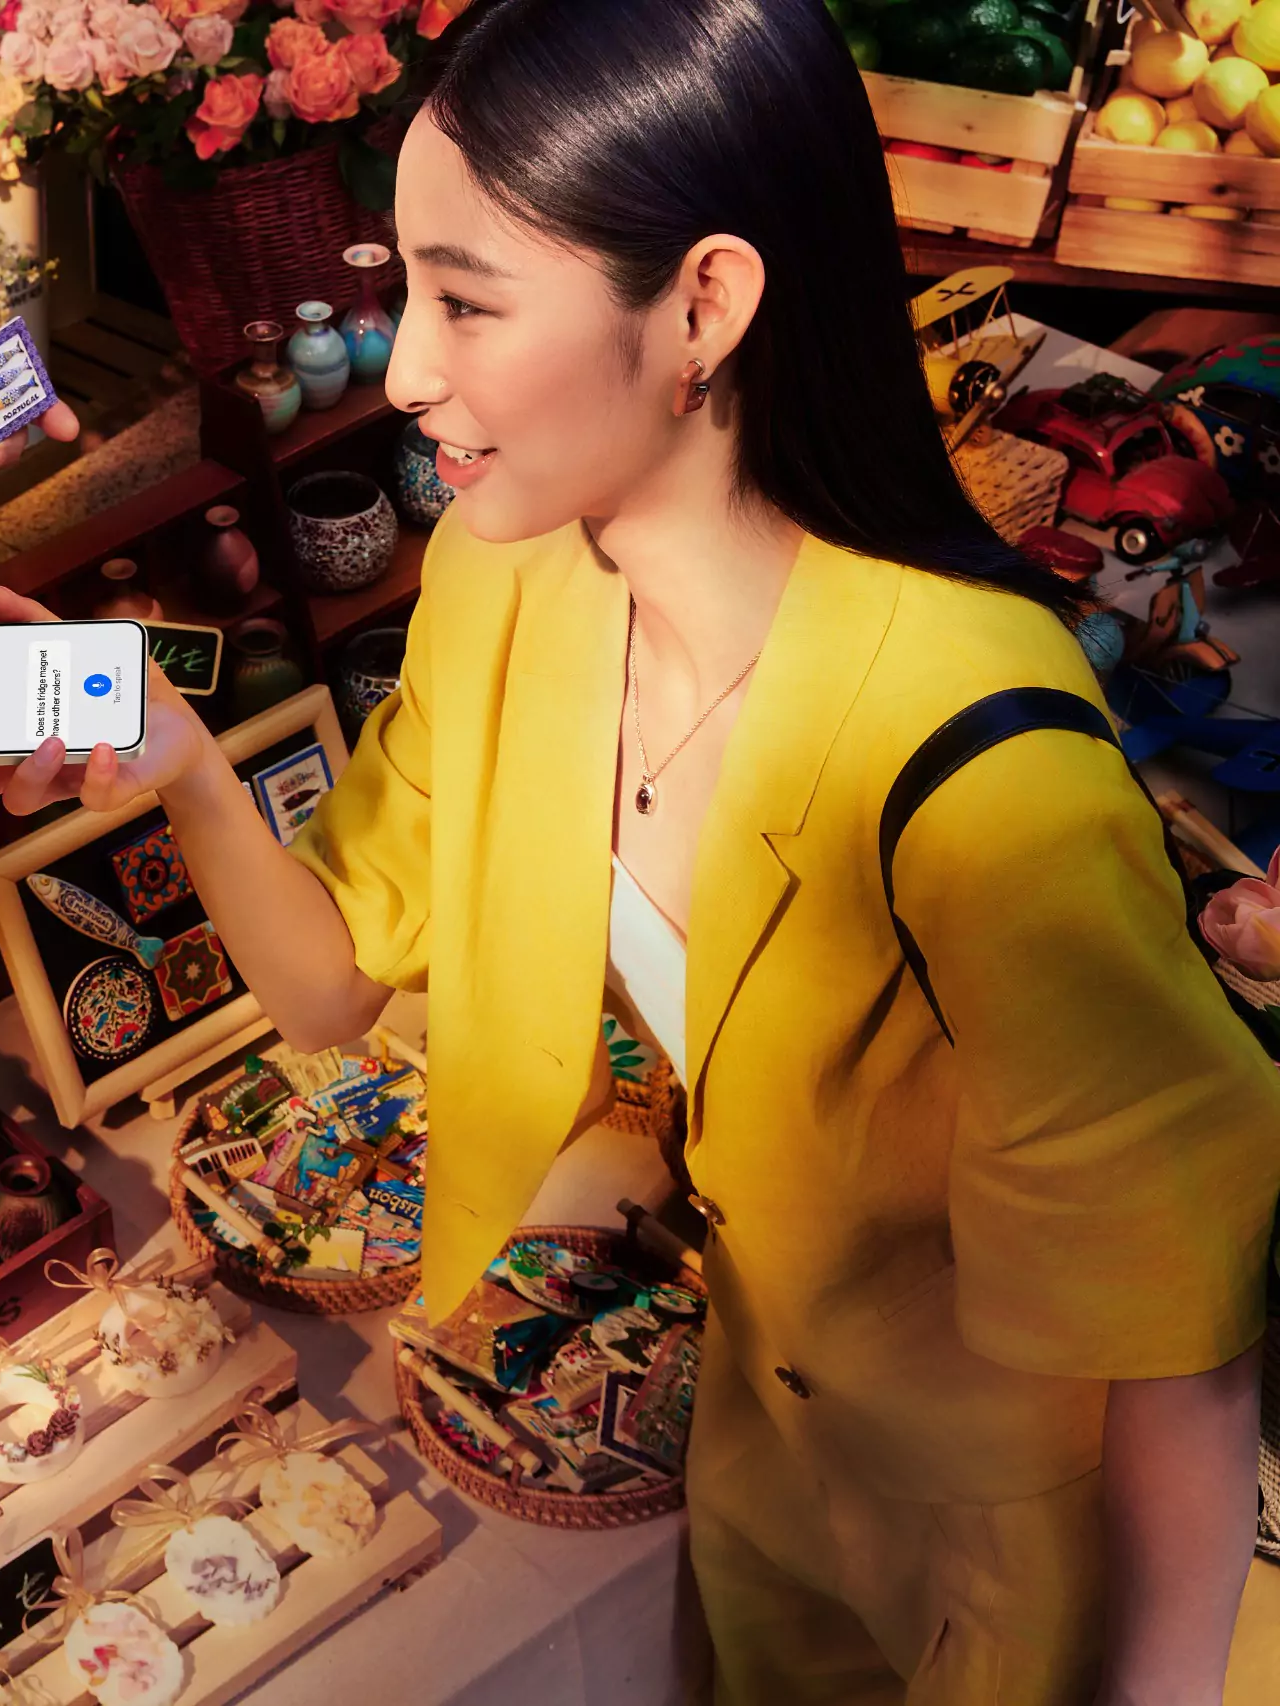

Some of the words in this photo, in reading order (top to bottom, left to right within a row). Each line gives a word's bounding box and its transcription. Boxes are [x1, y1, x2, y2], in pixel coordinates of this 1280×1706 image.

[3, 394, 40, 421] PORTUGAL
[39, 649, 48, 678] magnet
[52, 669, 61, 696] colors?
[114, 666, 123, 685] speak
[37, 678, 48, 701] fridge
[113, 693, 122, 704] Tap
[114, 684, 121, 693] to
[36, 701, 46, 716] this
[52, 697, 60, 717] other
[35, 717, 45, 737] Does
[51, 718, 60, 737] have
[74, 902, 110, 928] PORTUGAL
[368, 1187, 423, 1219] Lisbon
